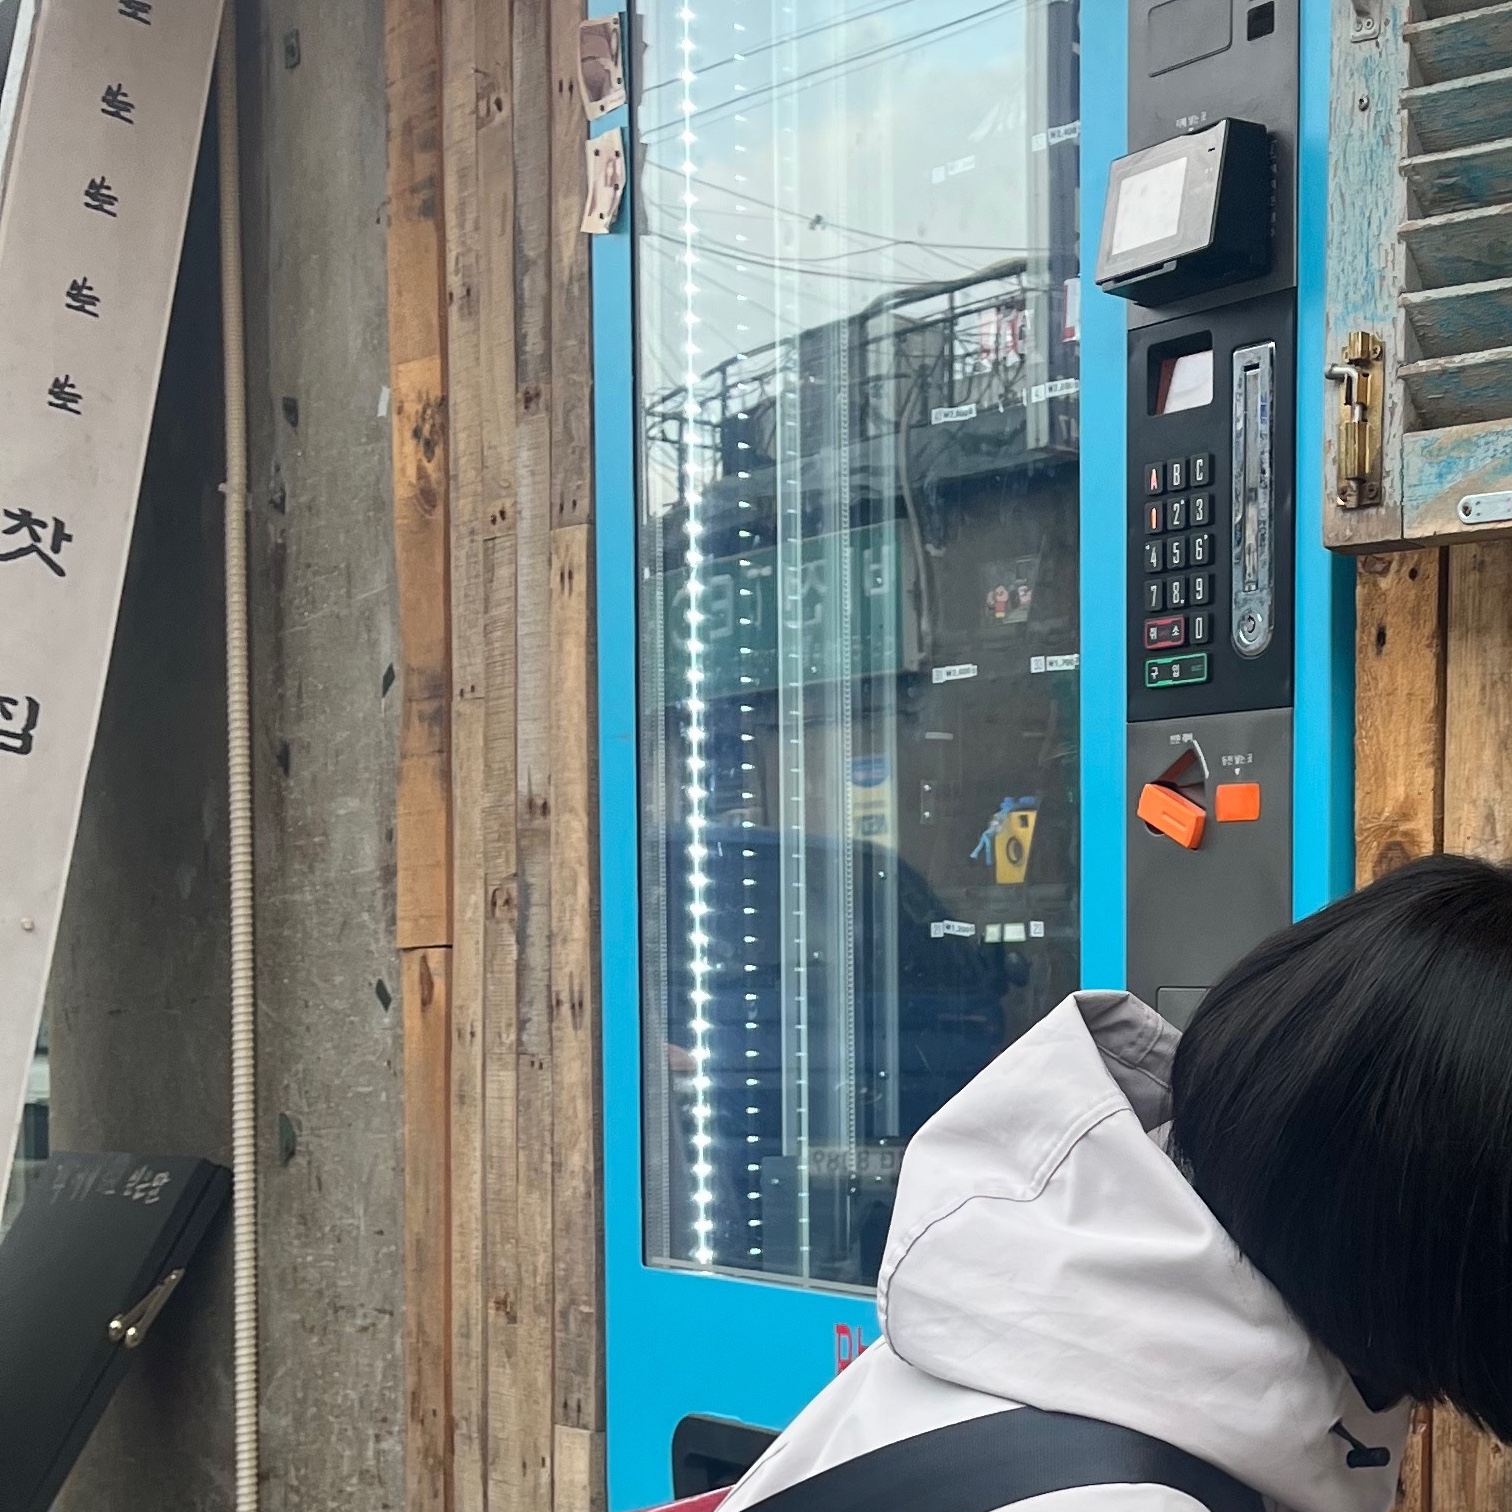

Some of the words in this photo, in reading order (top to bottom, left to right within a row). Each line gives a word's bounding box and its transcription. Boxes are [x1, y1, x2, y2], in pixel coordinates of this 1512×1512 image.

[1150, 467, 1158, 490] A
[1172, 463, 1181, 486] B
[1195, 458, 1203, 481] C
[1151, 507, 1157, 530] 1
[1172, 502, 1180, 525] 2
[1195, 498, 1203, 521] 3
[1150, 546, 1158, 568] 4
[1172, 541, 1180, 564] 5
[1195, 538, 1203, 560] 6
[1150, 585, 1158, 607] 7
[1172, 581, 1180, 604] 8
[1195, 577, 1203, 600] 9
[1195, 617, 1203, 639] 0
